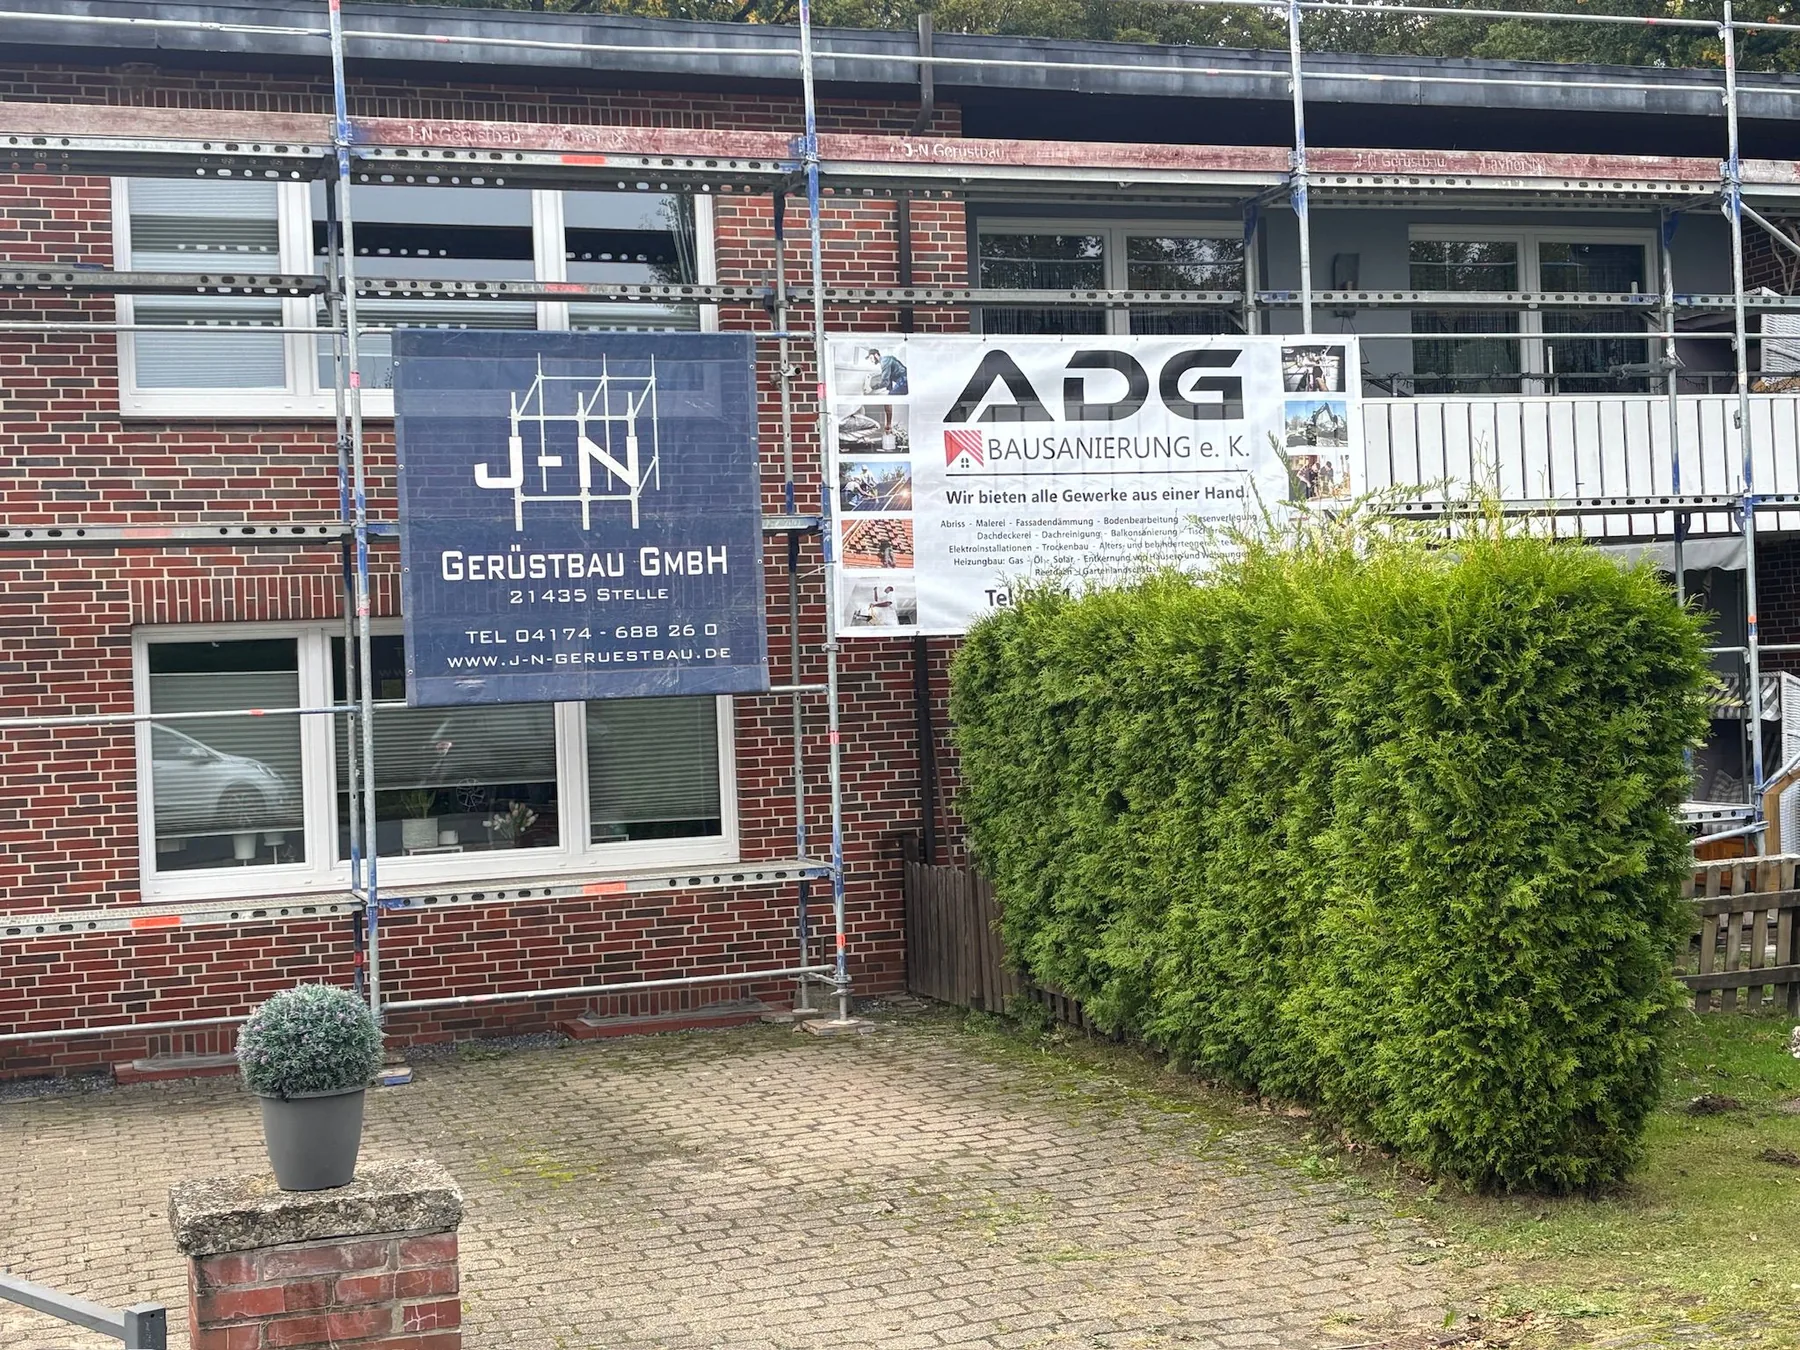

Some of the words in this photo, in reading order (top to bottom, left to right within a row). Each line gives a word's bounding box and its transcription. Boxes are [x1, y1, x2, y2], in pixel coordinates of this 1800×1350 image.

[943, 349, 1244, 422] ADG
[988, 435, 1190, 461] BAUSANIERUNG
[1200, 441, 1219, 457] e.
[1229, 435, 1250, 457] K.
[474, 436, 640, 489] J-N
[946, 490, 973, 504] Wir
[979, 488, 1026, 504] bieten
[1032, 487, 1058, 503] alle
[1063, 487, 1127, 502] Gewerke
[1133, 489, 1158, 501] aus
[1163, 486, 1200, 501] einer
[940, 519, 966, 528] Abriss
[975, 518, 1006, 528] Malerei
[1015, 517, 1094, 529] Fassadendämmung
[1103, 514, 1179, 525] Bodenbearbeitung
[977, 531, 1032, 540] Dachdeckerei
[1041, 530, 1101, 540] Dachreinigung
[1110, 528, 1178, 538] Balkonsanierung
[949, 543, 1032, 553] Elektroinstallationen
[1042, 543, 1089, 552] Trockenbau
[1127, 541, 1143, 549] und
[953, 556, 1006, 567] Heizungbau:
[1008, 556, 1024, 565] Gas
[1053, 555, 1074, 564] Solar
[1184, 551, 1200, 560] und
[509, 589, 588, 604] 21435
[465, 631, 507, 644] TEL
[515, 628, 592, 643] 04174
[615, 626, 658, 639] 688
[668, 625, 695, 638] 26
[704, 624, 718, 636] 0
